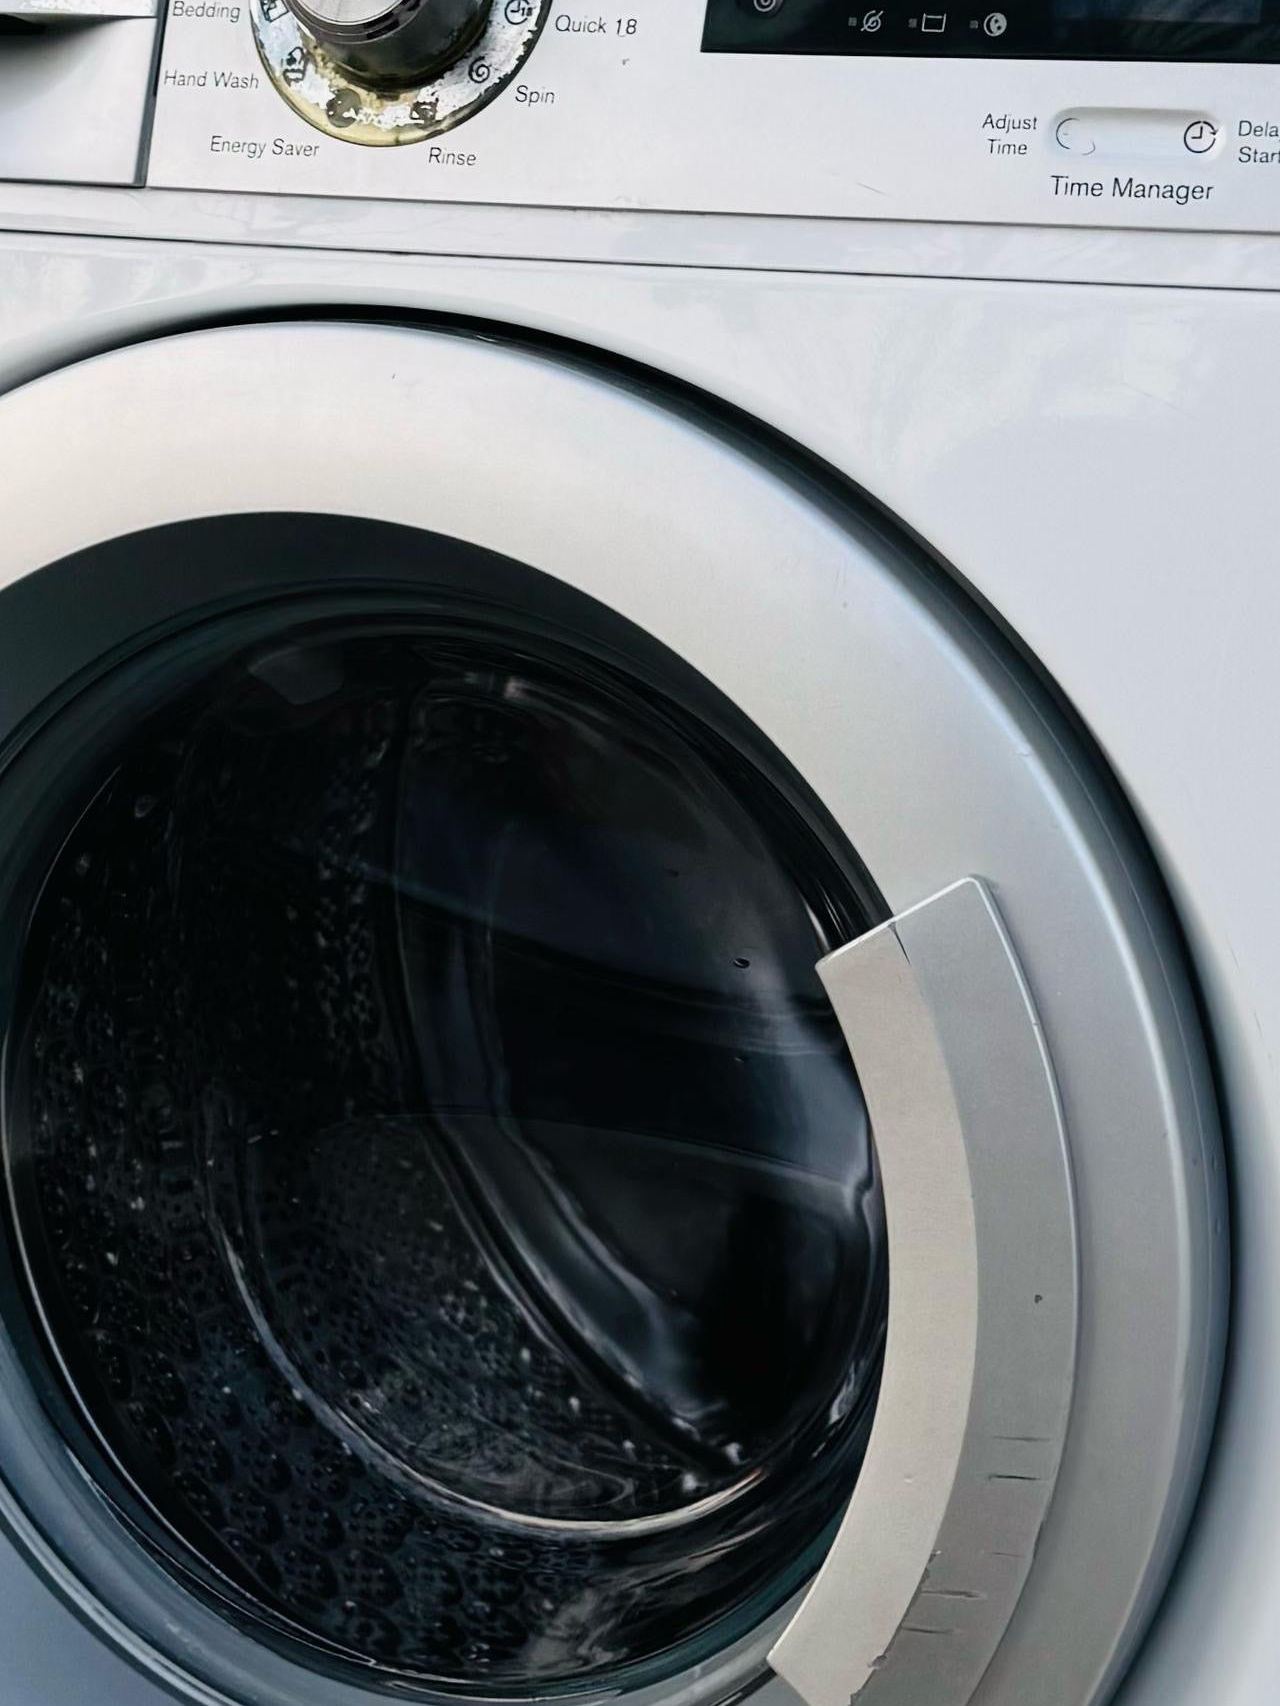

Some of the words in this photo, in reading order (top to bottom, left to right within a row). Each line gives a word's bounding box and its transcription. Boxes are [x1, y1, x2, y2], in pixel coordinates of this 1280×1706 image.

[172, 1, 241, 23] Bedding
[556, 16, 607, 35] Quick
[616, 18, 637, 37] 18
[164, 71, 207, 89] Hand
[212, 71, 260, 90] Wash
[515, 86, 555, 107] Spin
[982, 114, 1037, 133] Adjust
[210, 136, 266, 159] Energy
[272, 139, 320, 157] Saver
[428, 148, 476, 167] Rinse
[988, 139, 1028, 155] Time
[1051, 175, 1103, 197] Time
[1112, 177, 1214, 205] Manager
